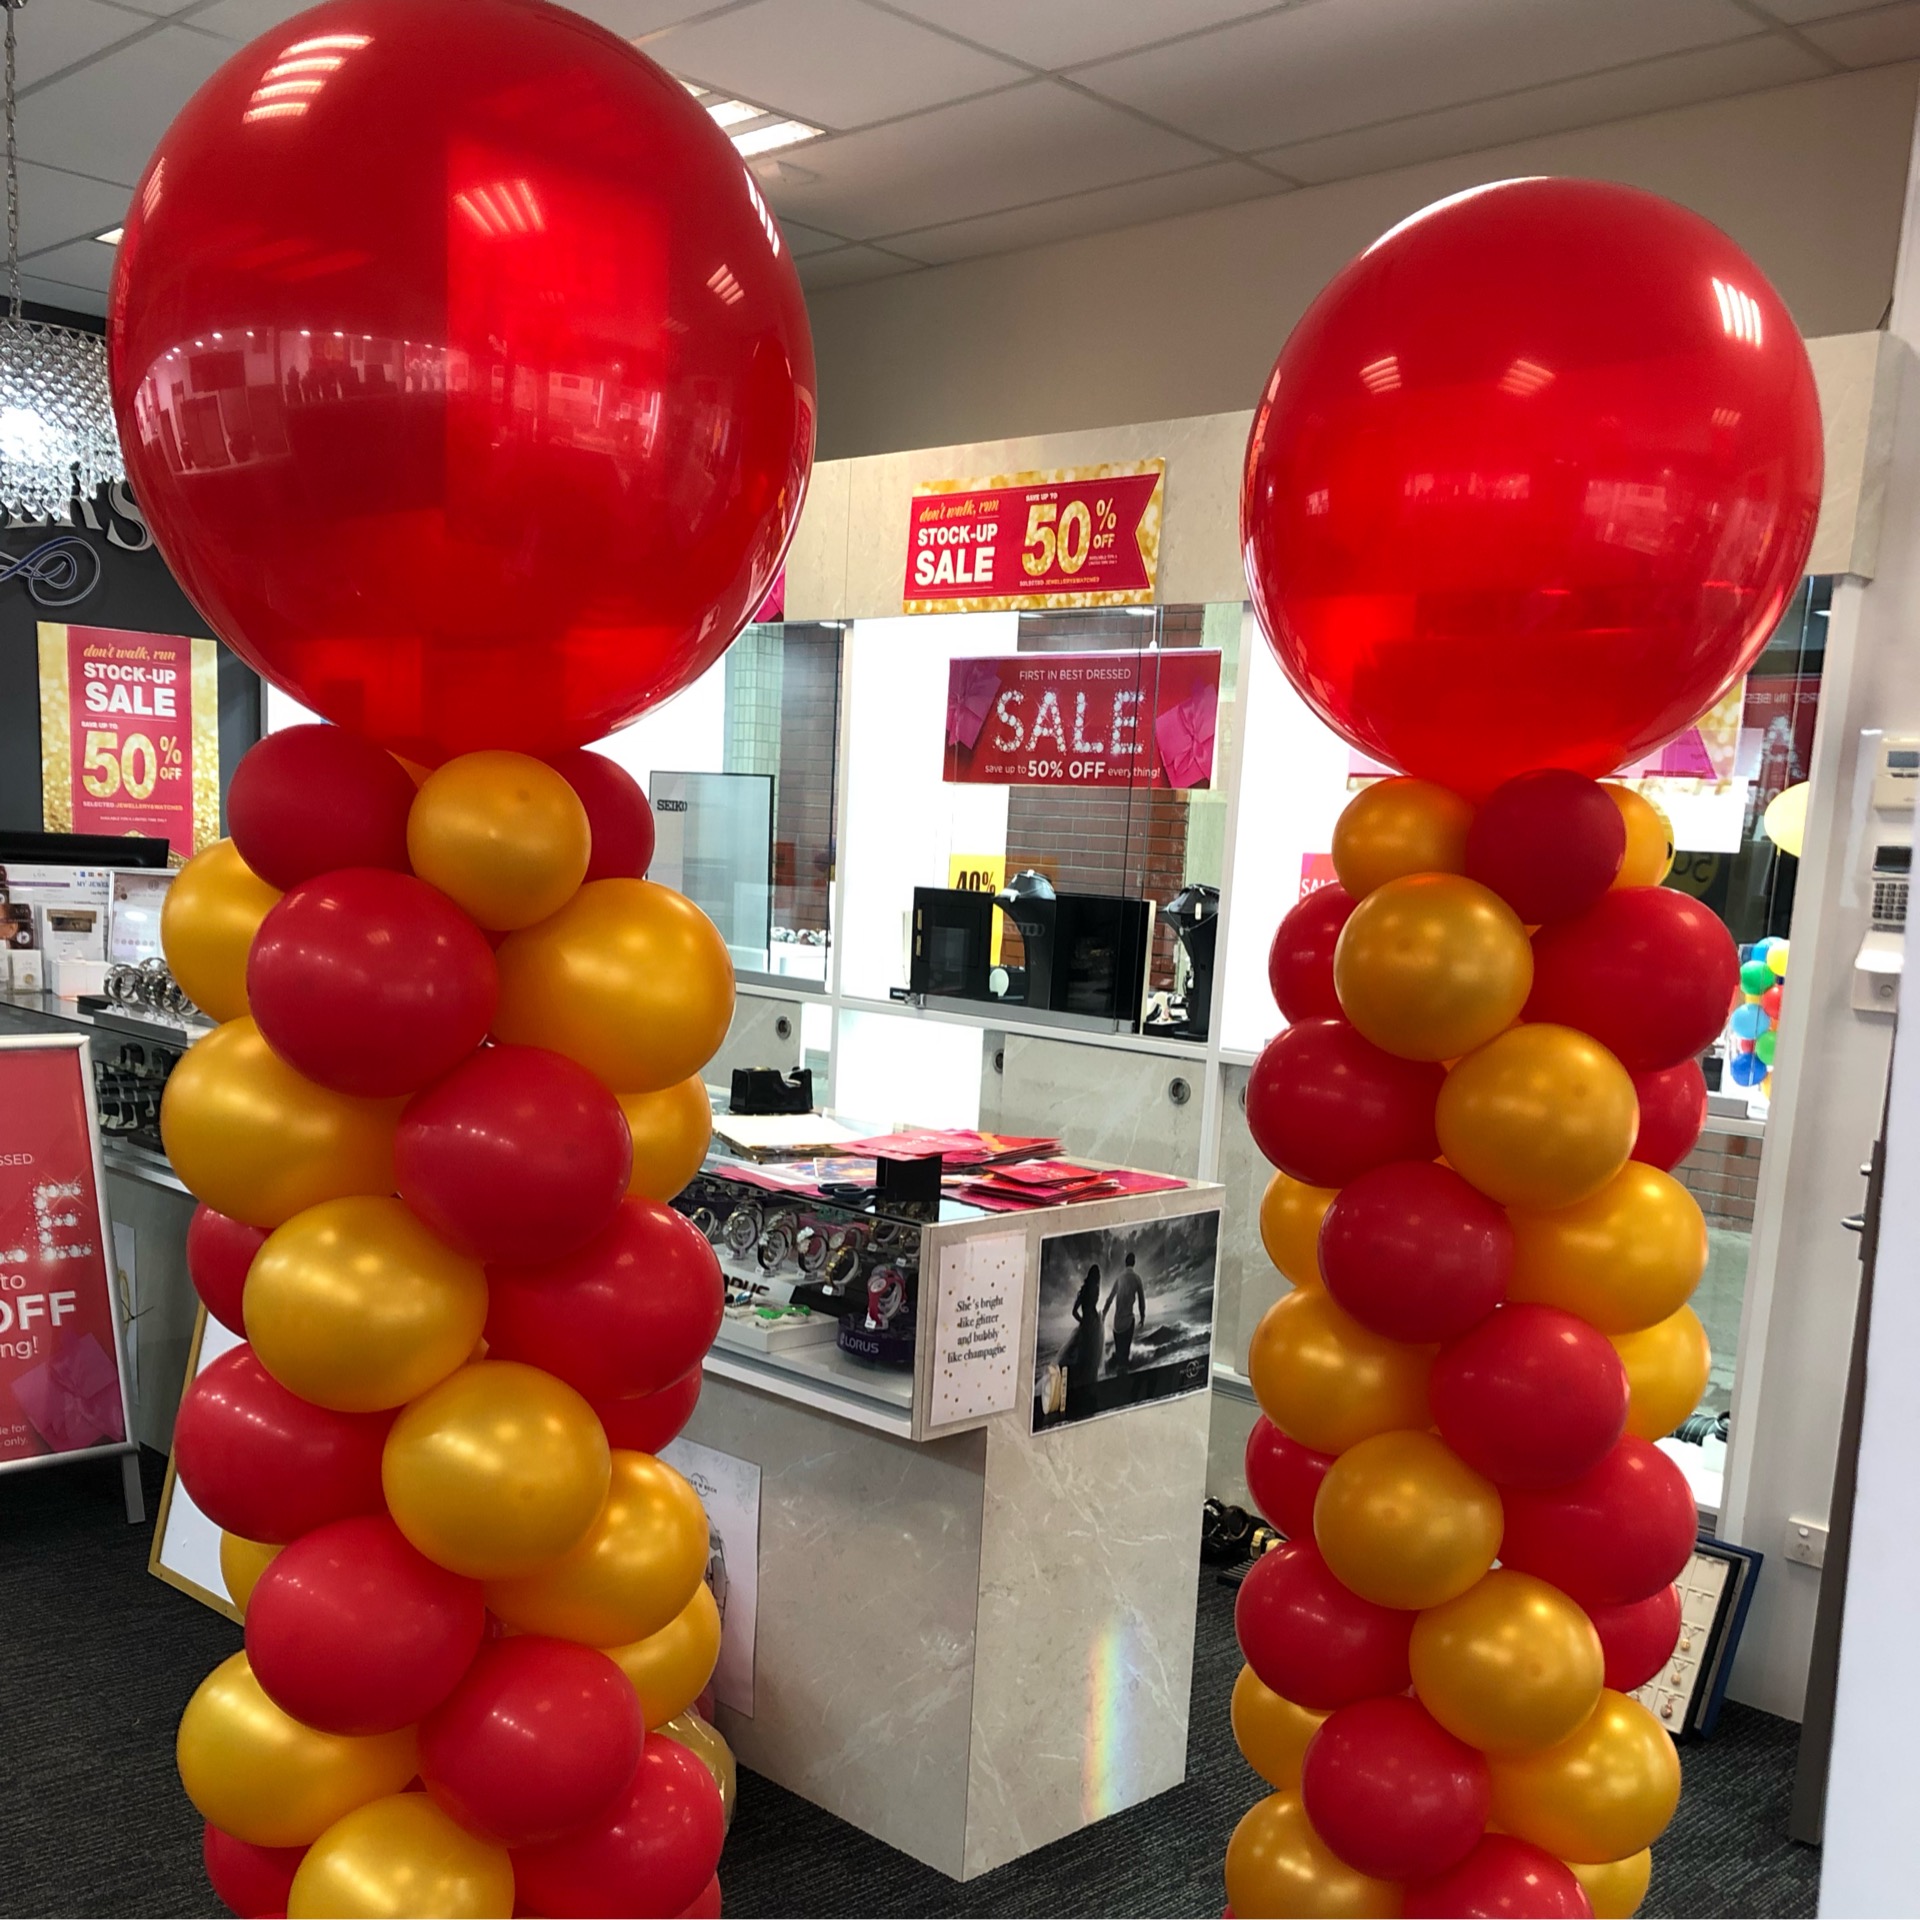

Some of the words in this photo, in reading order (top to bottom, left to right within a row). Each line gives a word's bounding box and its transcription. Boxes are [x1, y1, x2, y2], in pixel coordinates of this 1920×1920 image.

[1041, 493, 1049, 501] UP
[919, 502, 945, 523] don't
[979, 499, 999, 514] run
[917, 523, 998, 546] STOCK-UP
[1093, 533, 1115, 550] OFF
[914, 546, 995, 586] SALE
[83, 643, 114, 658] don't
[116, 646, 150, 661] walk,
[153, 650, 176, 661] run
[83, 662, 176, 684] STOCK-UP
[1019, 670, 1045, 681] FIRST
[1047, 669, 1057, 681] IN
[1060, 669, 1084, 681] BEST
[1086, 668, 1131, 681] DRESSED
[85, 681, 177, 717] SALE
[993, 688, 1146, 756] SALE
[160, 767, 182, 781] OFF
[985, 765, 1002, 773] save
[1005, 766, 1015, 775] up
[1017, 764, 1026, 774] to
[1027, 760, 1063, 778] 50%
[1069, 761, 1106, 779] OFF
[1108, 767, 1161, 780] everything!
[656, 799, 688, 812] SEIKO
[1300, 878, 1340, 897] SA
[0, 1153, 33, 1166] SED
[0, 1272, 26, 1291] to
[980, 1295, 1004, 1311] bright
[960, 1316, 974, 1329] like
[975, 1313, 999, 1330] glitter
[844, 1336, 879, 1354] LORUS
[957, 1332, 972, 1346] and
[973, 1328, 999, 1342] bubbly
[947, 1351, 963, 1364] like
[963, 1345, 1006, 1361] champagne
